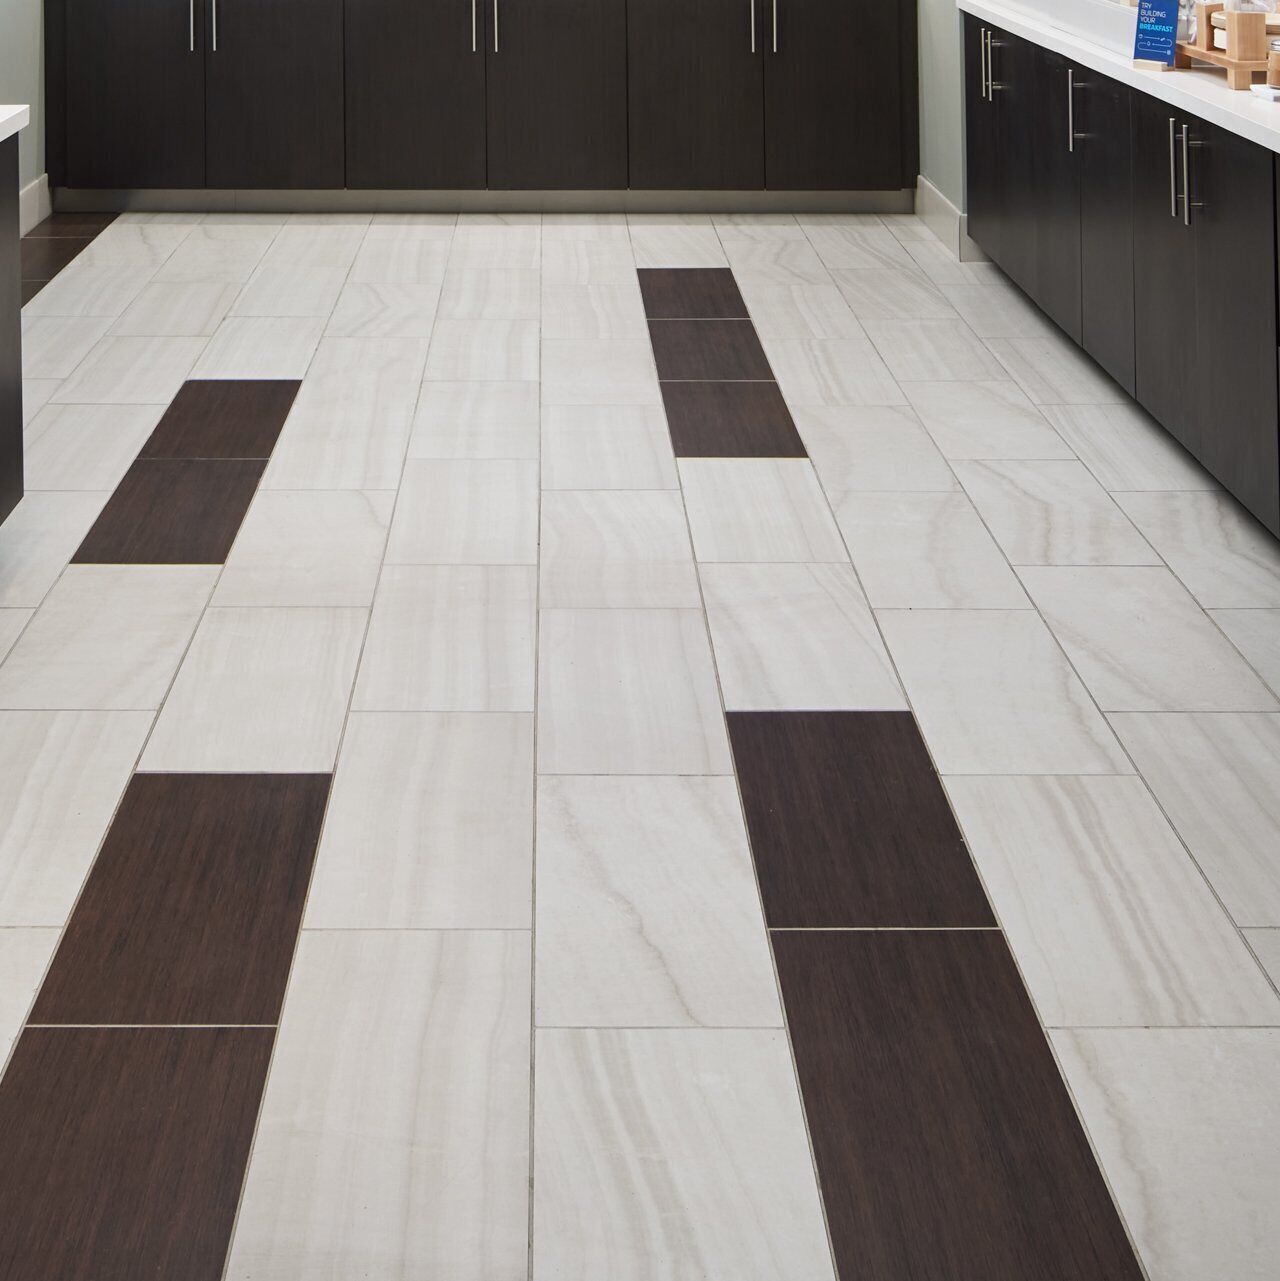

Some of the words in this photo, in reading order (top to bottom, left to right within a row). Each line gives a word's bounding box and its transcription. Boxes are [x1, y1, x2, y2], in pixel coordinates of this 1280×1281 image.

[1140, 9, 1167, 18] BUILDING
[1140, 16, 1156, 24] YOUR
[1140, 23, 1174, 33] BREAKFAST
